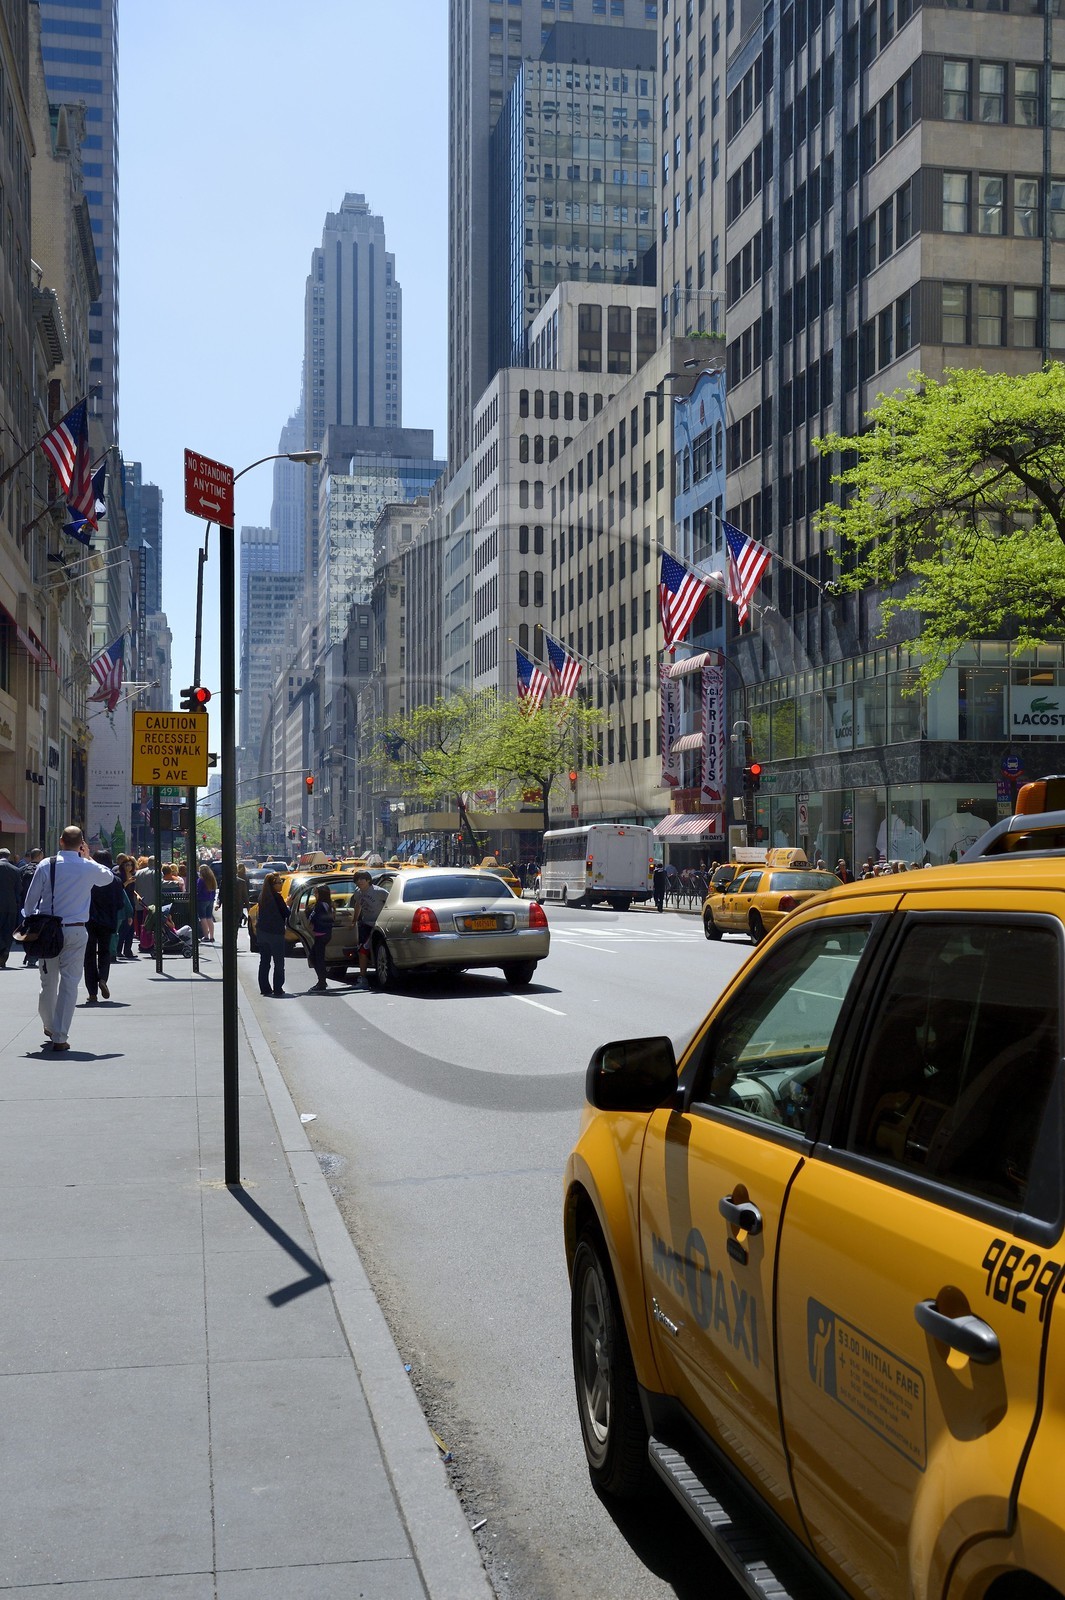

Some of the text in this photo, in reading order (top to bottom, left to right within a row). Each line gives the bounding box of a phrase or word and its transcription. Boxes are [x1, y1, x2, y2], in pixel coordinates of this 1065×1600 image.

[188, 457, 231, 485] NO STANDING
[193, 477, 226, 500] ANYTIME
[146, 717, 196, 729] CAUTION
[145, 733, 197, 744] RECESSED
[140, 745, 201, 756] CROSSWALK
[163, 757, 179, 767] ON
[152, 768, 188, 780] 5 AVE
[161, 787, 173, 796] 49
[839, 1329, 919, 1400] $3.00 INITIAL FARE
